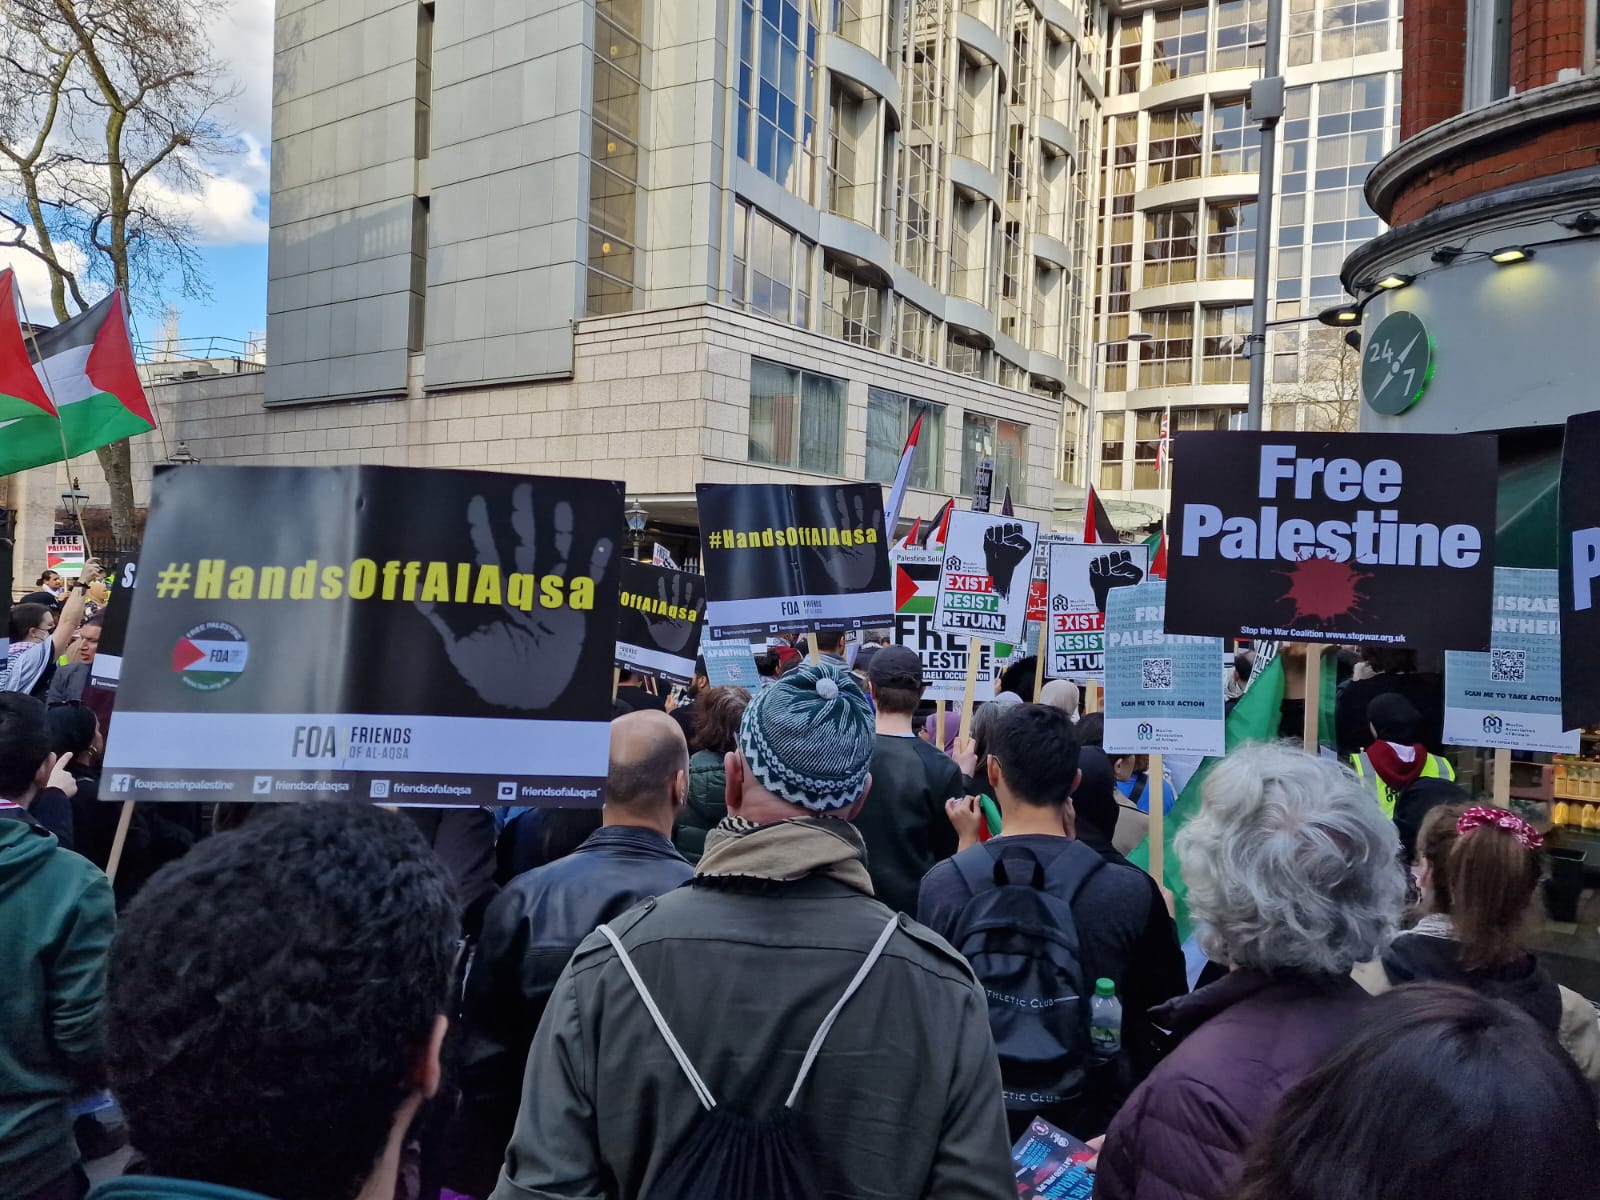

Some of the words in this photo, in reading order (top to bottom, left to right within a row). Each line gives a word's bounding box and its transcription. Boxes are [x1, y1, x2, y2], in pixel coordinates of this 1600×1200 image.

[1369, 339, 1394, 364] 24
[1403, 368, 1416, 397] 7
[1258, 445, 1402, 503] Free
[52, 536, 78, 545] FREE
[709, 527, 877, 549] #HandsOffAlAqsa
[1181, 503, 1482, 569] Palestine
[156, 558, 595, 611] #HandsOffAlAqsa
[946, 575, 992, 591] EXIST.
[620, 591, 697, 622] OffAlAqsa
[781, 600, 800, 616] FOA
[944, 593, 998, 610] RESIST.
[1497, 596, 1559, 612] ISRAE
[943, 612, 1004, 630] RETURN.
[1053, 615, 1104, 630] EXIST.
[1135, 606, 1165, 622] FR
[1055, 635, 1104, 650] RESIST
[1241, 626, 1258, 635] Stop
[1260, 627, 1272, 635] the
[1290, 629, 1324, 638] Coalition
[1326, 631, 1406, 643] www.stopwar.org.uk
[209, 649, 229, 663] FOA
[919, 652, 990, 669] LESTIE
[1056, 654, 1104, 671] RETU
[1530, 695, 1561, 703] ACTION
[292, 726, 336, 758] FOA
[351, 727, 411, 744] FRIENDS
[365, 746, 409, 760] AL-AQSA
[275, 780, 349, 793] friendsofalaqsa
[393, 783, 472, 796] friendsofalaqsa
[985, 990, 1026, 1007] THLETIC
[1001, 1090, 1026, 1101] ETIC
